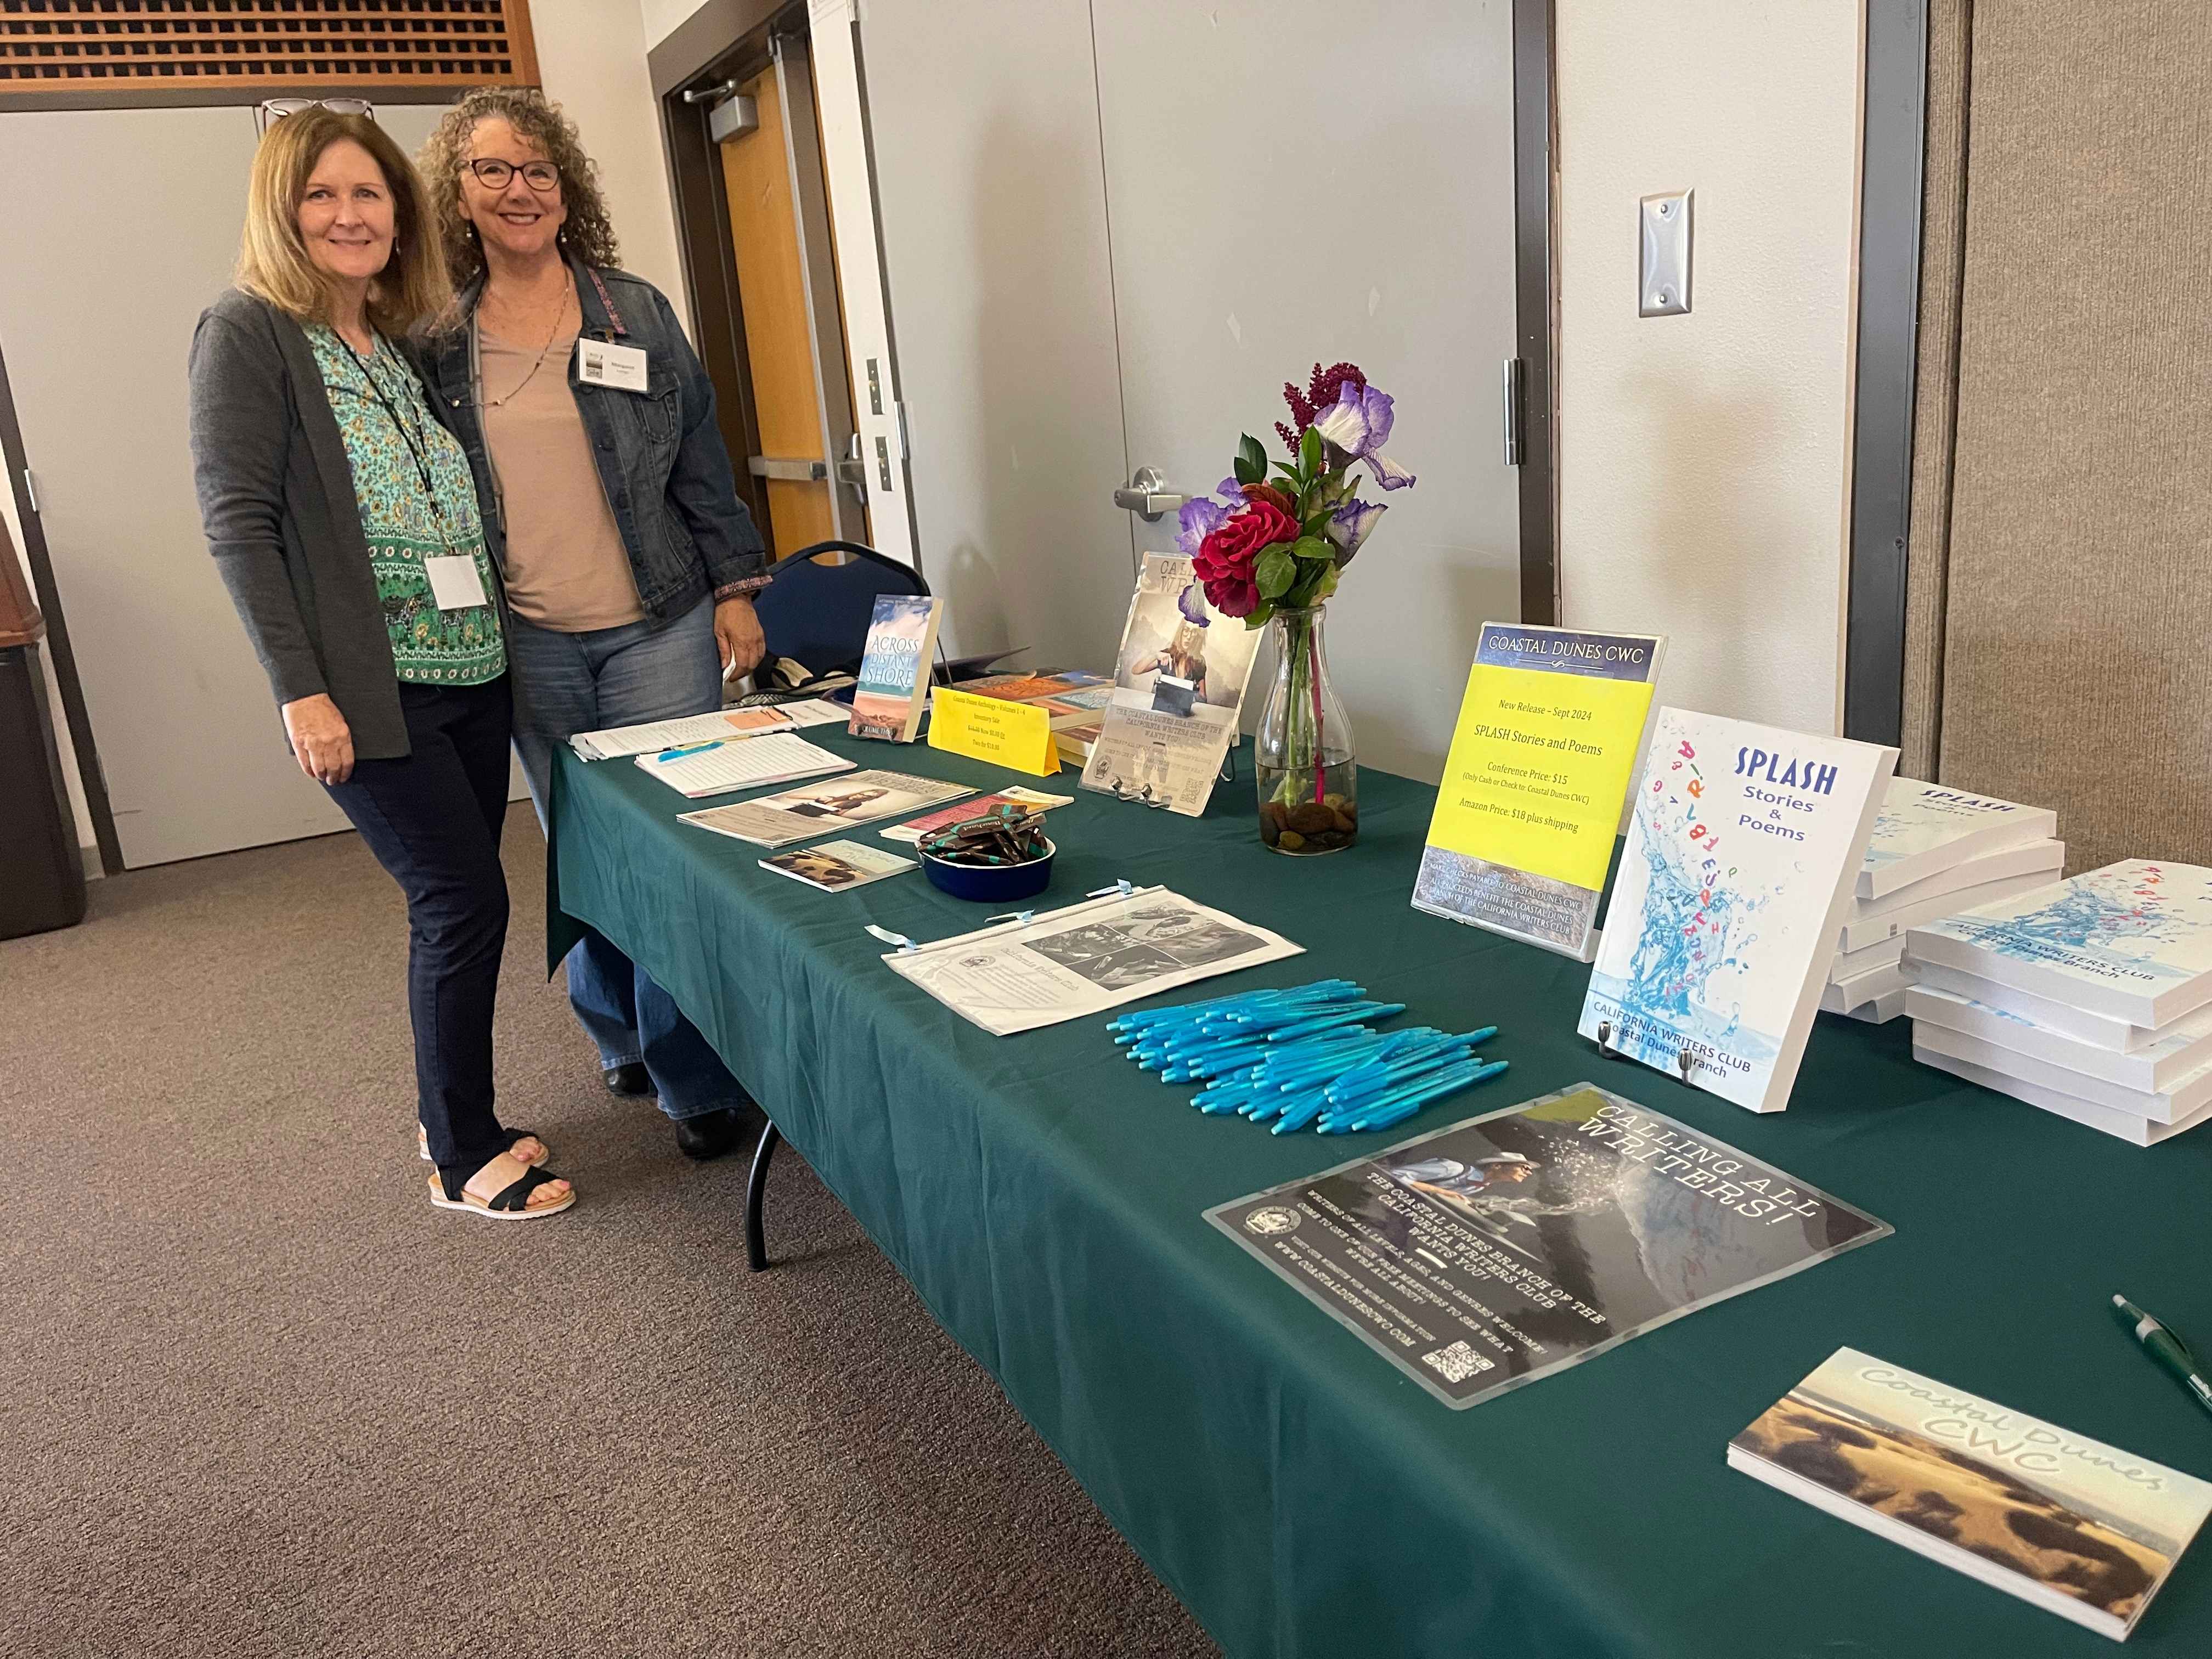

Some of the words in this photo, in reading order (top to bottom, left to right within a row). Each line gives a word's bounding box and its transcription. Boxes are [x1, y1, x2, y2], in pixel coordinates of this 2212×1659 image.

[1160, 561, 1193, 575] CALL
[871, 635, 919, 654] ACROSS
[871, 653, 913, 669] DISTANT
[1489, 635, 1548, 654] COASTAL
[1551, 641, 1602, 659] DUNES
[1605, 646, 1644, 663] CWC
[866, 666, 913, 689] SHORE
[1498, 699, 1516, 710] New
[1517, 702, 1545, 714] Release
[1553, 707, 1570, 719] Sept
[1571, 709, 1592, 720] 2024
[1474, 724, 1511, 740] SPLASH
[1511, 730, 1545, 746] Stories
[1547, 738, 1567, 750] and
[1568, 740, 1602, 756] Poems
[1487, 761, 1528, 777] Conference
[1530, 769, 1551, 781] Price:
[1552, 773, 1568, 785] $15
[1734, 746, 1838, 795] SPLASH
[1463, 772, 1478, 783] (Only
[1479, 775, 1492, 785] Cash
[1500, 779, 1518, 790] Check
[1527, 785, 1549, 796] Coastal
[1550, 789, 1570, 800] Dunes
[1571, 793, 1590, 805] CWC)
[1743, 786, 1814, 812] Stories
[1920, 790, 2016, 811] SPLASH
[1459, 797, 1488, 811] Amazon
[1489, 803, 1510, 816] Price:
[1511, 808, 1526, 820] $18
[1526, 812, 1543, 824] plus
[1544, 816, 1579, 834] shipping
[1739, 814, 1805, 842] Poems
[1769, 809, 1781, 820] &
[1441, 881, 1473, 896] PROCEEDS
[1474, 889, 1500, 904] BENEFIT
[1501, 896, 1514, 907] THE
[1515, 901, 1545, 917] COASTAL
[1548, 911, 1573, 924] DUNES
[1446, 868, 1469, 878] CHECKS
[1469, 873, 1494, 885] PAYABLE
[1506, 883, 1536, 898] COASTAL
[1538, 891, 1562, 905] DUNES
[1564, 899, 1581, 910] CWC
[1454, 894, 1463, 903] OF
[1464, 896, 1477, 907] THE
[1478, 901, 1518, 919] CALIFORNIA
[1519, 912, 1549, 928] WRITERS
[1945, 922, 2032, 947] CALIFORNIA
[2037, 945, 2109, 969] WRITERS
[2111, 966, 2156, 981] CLUB
[2062, 959, 2121, 979] Branch
[1594, 1001, 1658, 1035] CALIFORNIA
[1661, 1028, 1716, 1058] WRITERS
[1718, 1052, 1751, 1073] CLUB
[1693, 1057, 1727, 1078] ranch
[1578, 1117, 1794, 1225] WRITERS!
[1596, 1106, 1743, 1175] CALLING
[1740, 1178, 1820, 1217] ALL
[1367, 1172, 1395, 1190] THE
[1391, 1188, 1446, 1224] COASTAL
[1444, 1223, 1493, 1252] DUNES
[1488, 1251, 1553, 1290] BRANCH
[1550, 1289, 1573, 1301] OF
[1571, 1301, 1606, 1324] THE
[1378, 1194, 1453, 1243] CALIFORNIA
[1454, 1242, 1519, 1284] WRITERS
[1516, 1283, 1557, 1308] CLUB
[1409, 1226, 1457, 1259] WANTS
[1455, 1257, 1492, 1280] YOU!
[1308, 1189, 1344, 1216] WRITERS
[1341, 1214, 1356, 1223] OF
[1351, 1223, 1372, 1234] ALL
[1430, 1276, 1454, 1290] AND
[1453, 1290, 1494, 1317] GENRES
[1492, 1316, 1549, 1355] WELCOME!
[1318, 1217, 1333, 1227] TO
[1398, 1273, 1449, 1308] MEETINGS
[1446, 1306, 1462, 1317] TO
[1459, 1316, 1481, 1330] SEE
[1480, 1329, 1514, 1352] WHAT
[1370, 1267, 1391, 1282] ALL
[1861, 1368, 2010, 1431] Coastal
[2024, 1427, 2163, 1490] Dunes
[1924, 1419, 2060, 1472] CWC
